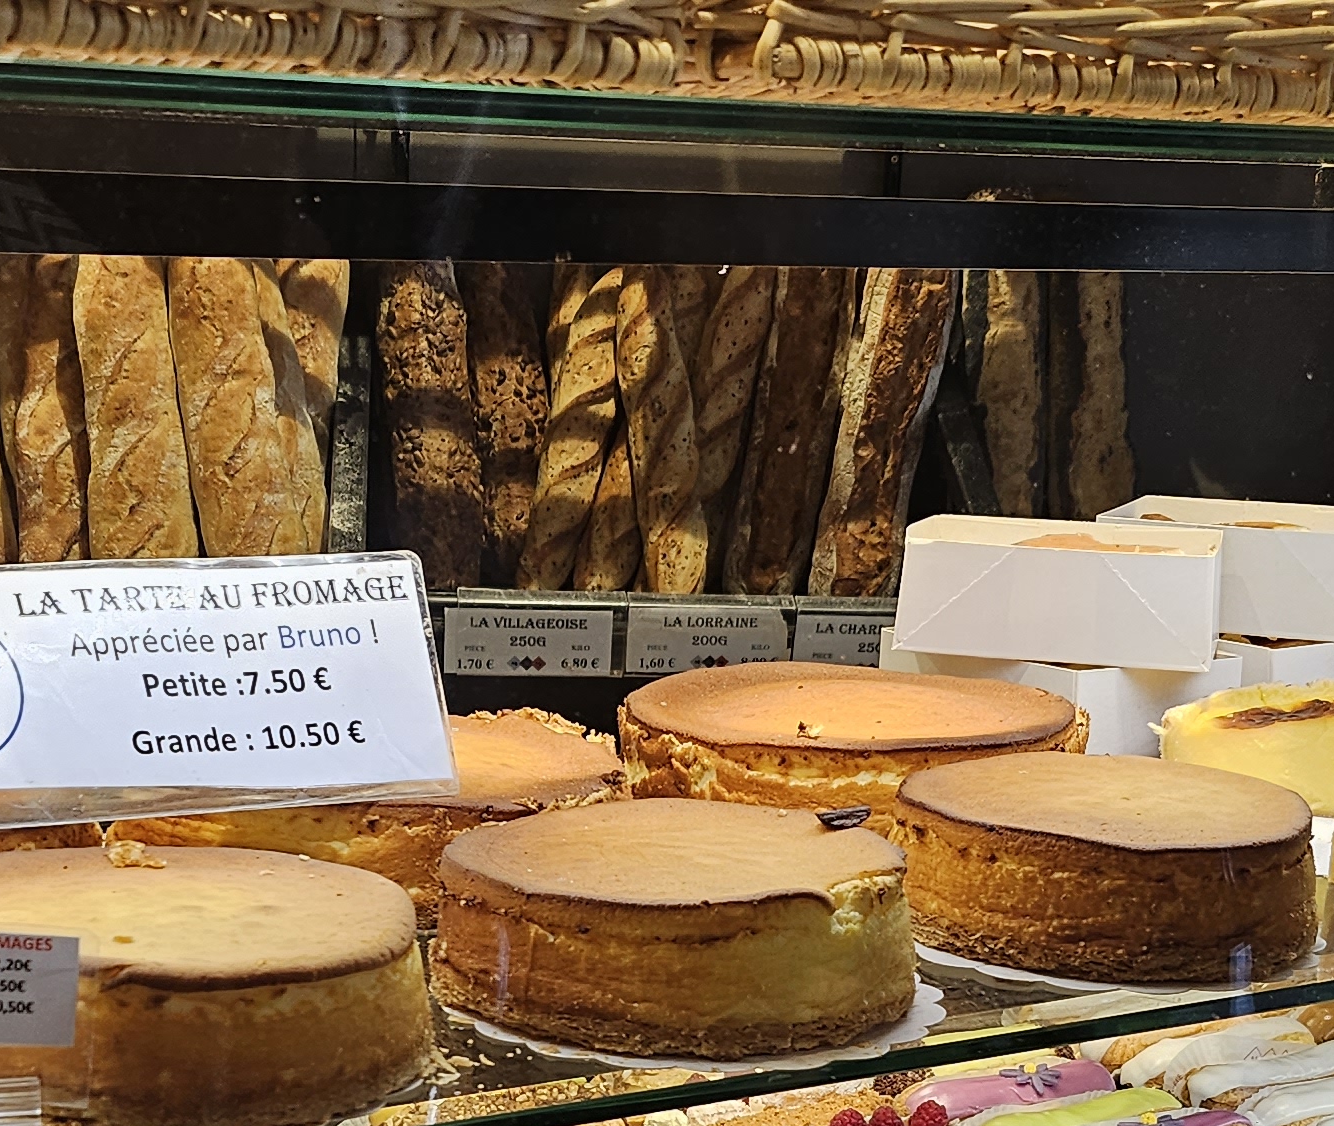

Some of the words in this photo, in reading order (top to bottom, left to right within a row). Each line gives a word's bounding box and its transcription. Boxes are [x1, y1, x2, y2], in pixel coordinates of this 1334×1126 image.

[13, 592, 67, 617] LA
[72, 586, 188, 613] TARTE
[199, 584, 244, 610] AU
[251, 575, 410, 608] FROMAGE
[470, 617, 489, 628] LA
[494, 616, 588, 630] VILLAGEOISE
[663, 616, 682, 628] LA
[687, 616, 758, 629] LORRAINE
[815, 623, 835, 635] LA
[71, 627, 216, 661] Appréciée
[225, 633, 269, 658] par
[278, 623, 362, 650] Bruno
[510, 635, 547, 647] 250G
[691, 635, 728, 647] 200G
[142, 671, 228, 698] Petite
[313, 667, 332, 691] €
[132, 728, 238, 755] Grande
[264, 721, 341, 751] 10.50
[347, 719, 366, 744] €
